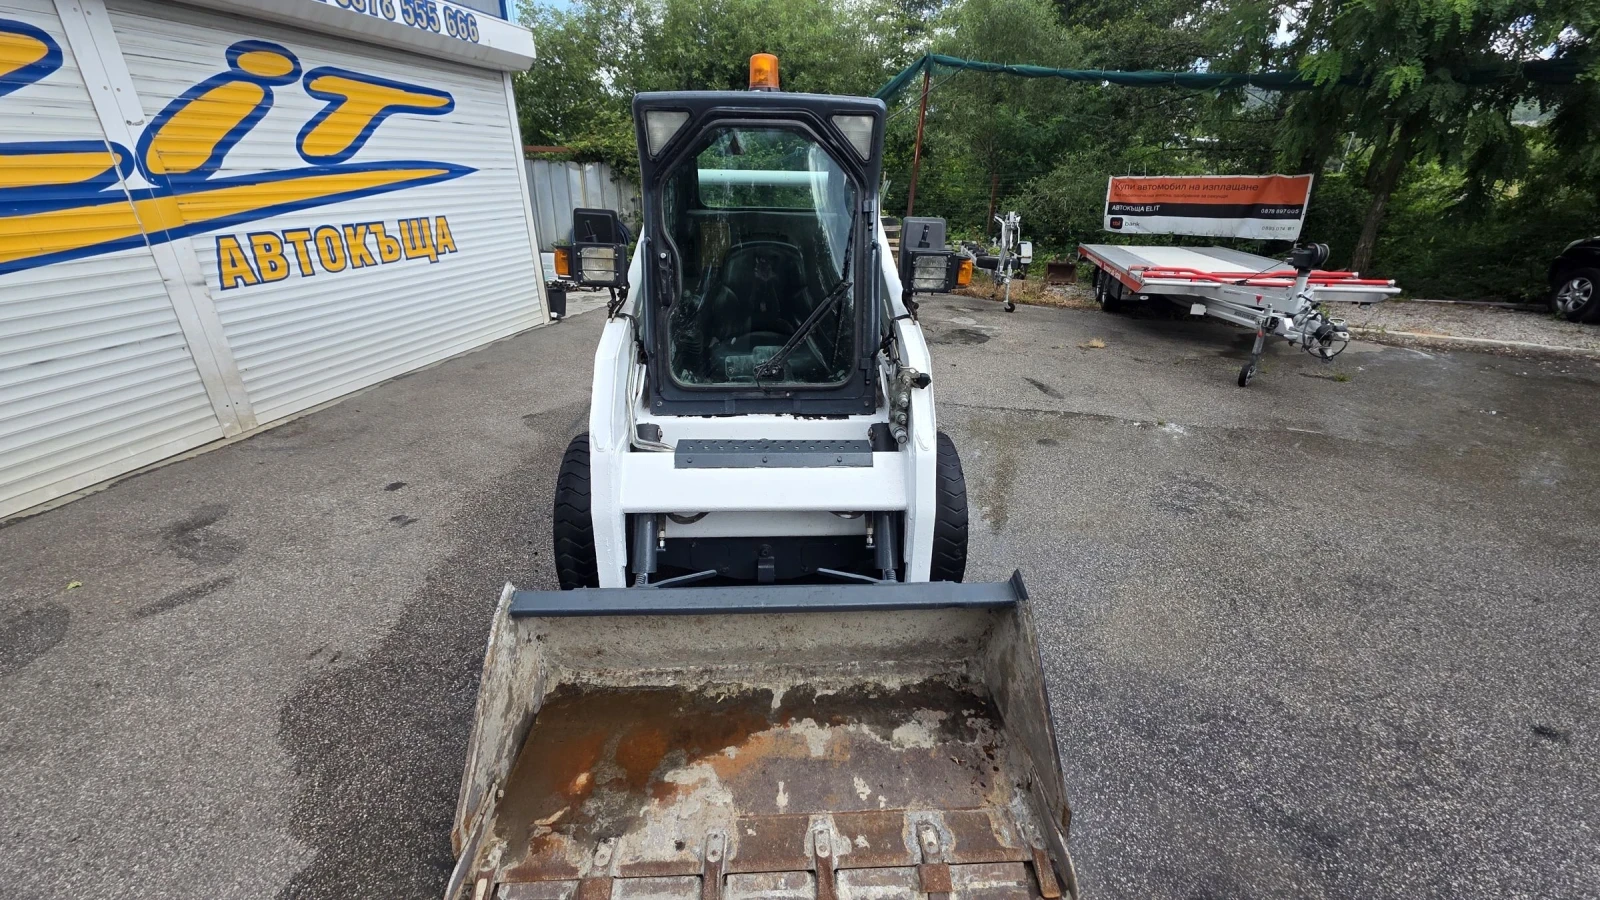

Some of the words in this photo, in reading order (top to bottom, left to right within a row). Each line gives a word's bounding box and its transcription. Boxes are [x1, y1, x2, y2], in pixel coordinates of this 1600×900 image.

[400, 0, 441, 33] 555
[443, 5, 480, 43] 666
[1114, 182, 1136, 191] Купи
[1137, 182, 1187, 191] автомобил
[1202, 183, 1259, 191] изплащане
[1111, 204, 1145, 212] АВТОКЪЩА
[1146, 204, 1160, 212] ELIT
[215, 215, 458, 291] АВТОКЪЩА
